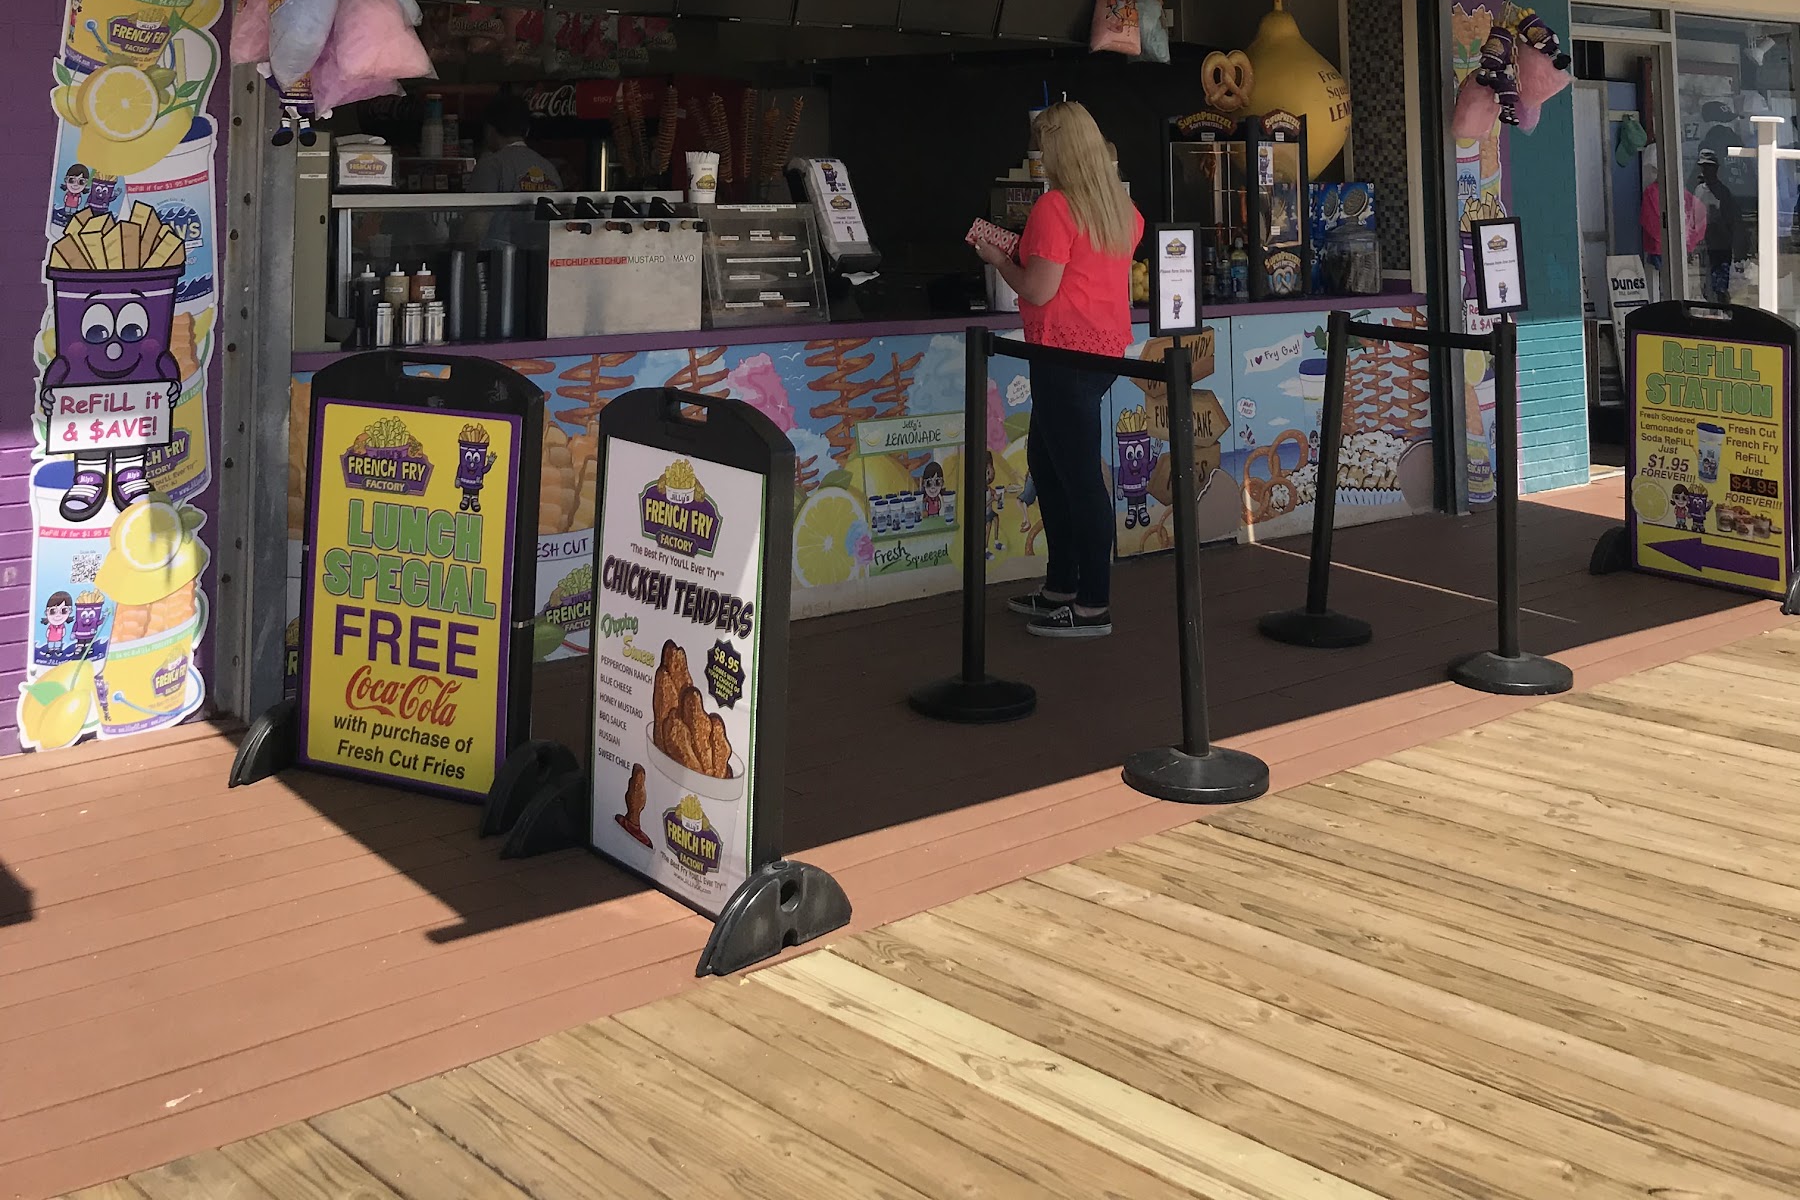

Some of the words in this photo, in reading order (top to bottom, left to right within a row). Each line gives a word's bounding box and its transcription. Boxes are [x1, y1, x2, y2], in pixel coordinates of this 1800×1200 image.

[112, 23, 151, 44] FRENCH
[550, 258, 589, 268] KETCHUP
[589, 256, 627, 266] KETCHUP
[628, 254, 665, 264] MUSTARD
[672, 254, 695, 263] MAYO
[1264, 350, 1280, 361] Fry
[145, 390, 163, 410] it
[1646, 372, 1773, 418] STATION
[1639, 410, 1660, 422] Fresh
[1661, 413, 1696, 425] Squeezed
[1640, 421, 1684, 435] Lemonade
[1686, 428, 1695, 436] or
[62, 421, 79, 442] &
[89, 415, 158, 444] $AVE!
[885, 428, 942, 448] LEMONADE
[1641, 433, 1663, 444] Soda
[1728, 423, 1756, 435] Fresh
[1758, 427, 1777, 439] Cut
[164, 436, 187, 460] FRY
[1658, 445, 1678, 455] Just
[1726, 437, 1760, 450] French
[1762, 441, 1779, 455] Fry
[146, 462, 172, 479] CTORY
[348, 455, 398, 479] FRENCH
[402, 462, 426, 482] FRY
[1648, 453, 1690, 473] $1.95
[1742, 466, 1764, 478] Just
[365, 478, 405, 492] FACTORY
[1731, 476, 1777, 496] $4.95
[645, 497, 689, 533] FRENCH
[691, 509, 714, 540] FRY
[347, 498, 483, 564] LUNCH
[536, 542, 560, 559] ESH
[563, 537, 589, 556] CUT
[660, 533, 694, 553] FACTORY
[643, 546, 658, 560] Best
[658, 550, 669, 565] Fry
[690, 562, 706, 576] Ever
[323, 547, 496, 620] SPECIAL
[602, 554, 673, 611] CHICKEN
[673, 578, 754, 640] TENDERS
[546, 600, 592, 625] FRENCH
[564, 619, 591, 632] FACTO
[601, 612, 639, 639] Dipping
[334, 603, 479, 680] FREE
[600, 654, 634, 678] PEPPERCORN
[634, 667, 653, 685] RANCH
[713, 646, 740, 673] $8.95
[600, 673, 613, 688] BLUE
[613, 678, 633, 696] CHEESE
[345, 665, 463, 728] Coca-Cola
[599, 692, 618, 708] HONEY
[617, 698, 644, 719] MUSTARD
[599, 709, 610, 725] BBQ
[610, 715, 627, 732] SAUCE
[334, 713, 367, 734] with
[371, 721, 450, 749] purchase
[454, 736, 474, 754] of
[598, 728, 621, 747] RUSSIAN
[337, 738, 383, 764] Fresh
[389, 749, 419, 771] Cut
[422, 756, 466, 780] Fries
[598, 747, 616, 763] SWEET
[615, 755, 631, 771] CHILE
[667, 819, 699, 855] FRENCH
[700, 837, 717, 860] FRY
